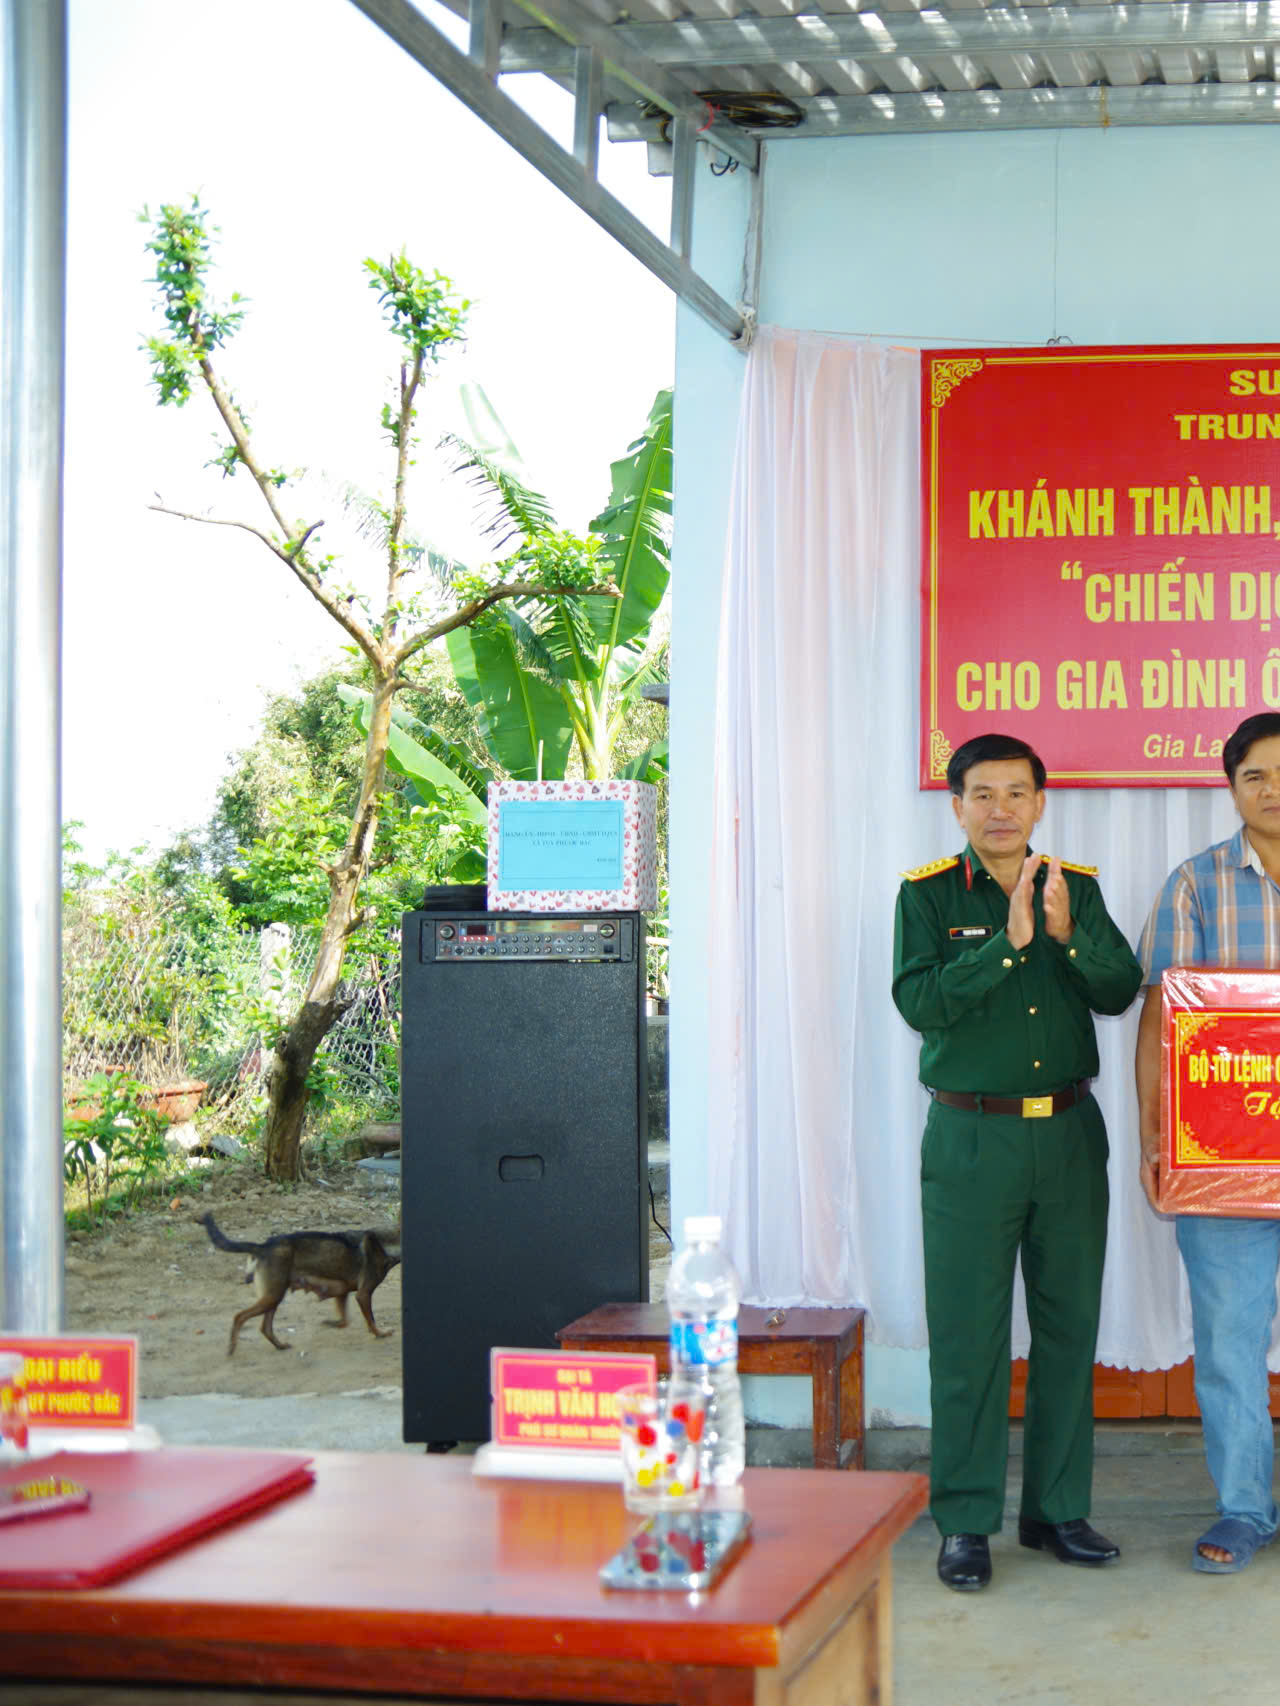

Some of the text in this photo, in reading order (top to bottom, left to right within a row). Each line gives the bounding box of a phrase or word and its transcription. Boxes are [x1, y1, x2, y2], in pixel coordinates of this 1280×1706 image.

[969, 479, 1114, 538] KHÁNH
[1061, 557, 1215, 623] “CHIẾN
[956, 661, 1041, 711] CHO
[1056, 660, 1128, 710] GIA
[1141, 649, 1246, 709] ĐÌNH
[1143, 733, 1185, 758] Gia
[1193, 733, 1231, 757] La
[1189, 1048, 1210, 1088] BỘ
[1234, 1048, 1272, 1088] LỆNH
